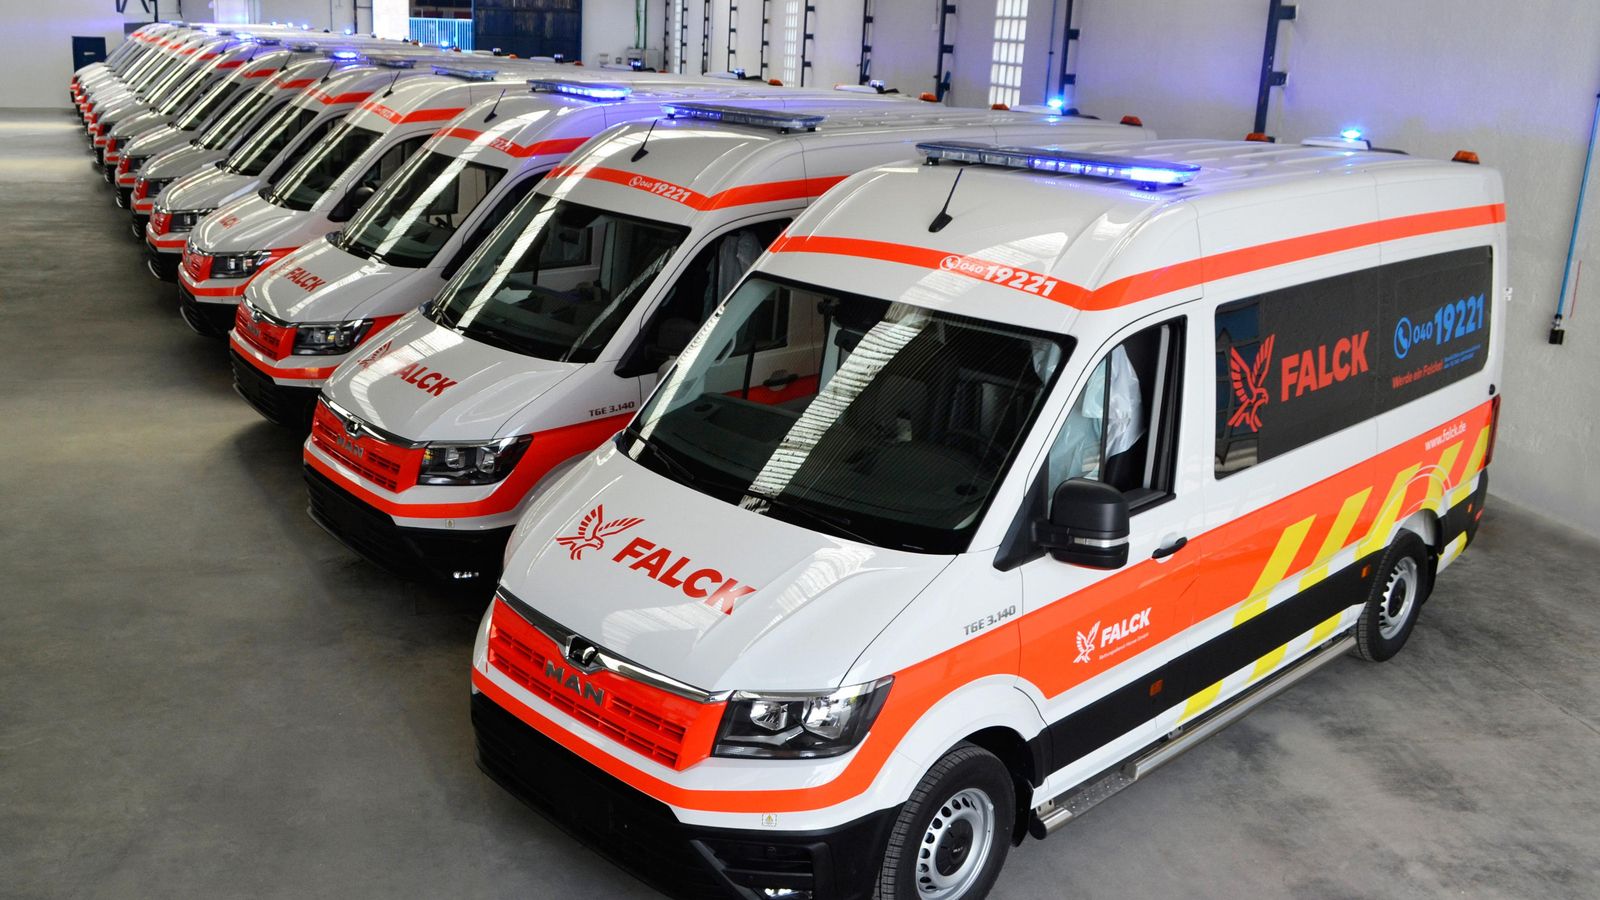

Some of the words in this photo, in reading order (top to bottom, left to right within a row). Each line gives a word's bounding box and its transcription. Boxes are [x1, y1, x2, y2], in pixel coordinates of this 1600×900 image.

[651, 182, 692, 203] 19221
[284, 267, 326, 292] FALCK
[960, 262, 983, 274] 040
[983, 264, 1058, 297] 19221
[1413, 323, 1433, 344] 040
[1434, 293, 1484, 345] 19221
[392, 363, 458, 397] ALCK
[1281, 330, 1370, 402] FALCK
[589, 407, 607, 417] TGE
[609, 401, 635, 413] 3.140
[612, 536, 757, 615] FALCK
[963, 618, 985, 636] TGE
[986, 604, 1016, 626] 3.140
[1100, 607, 1152, 649] FALCK
[545, 659, 604, 706] MAN
